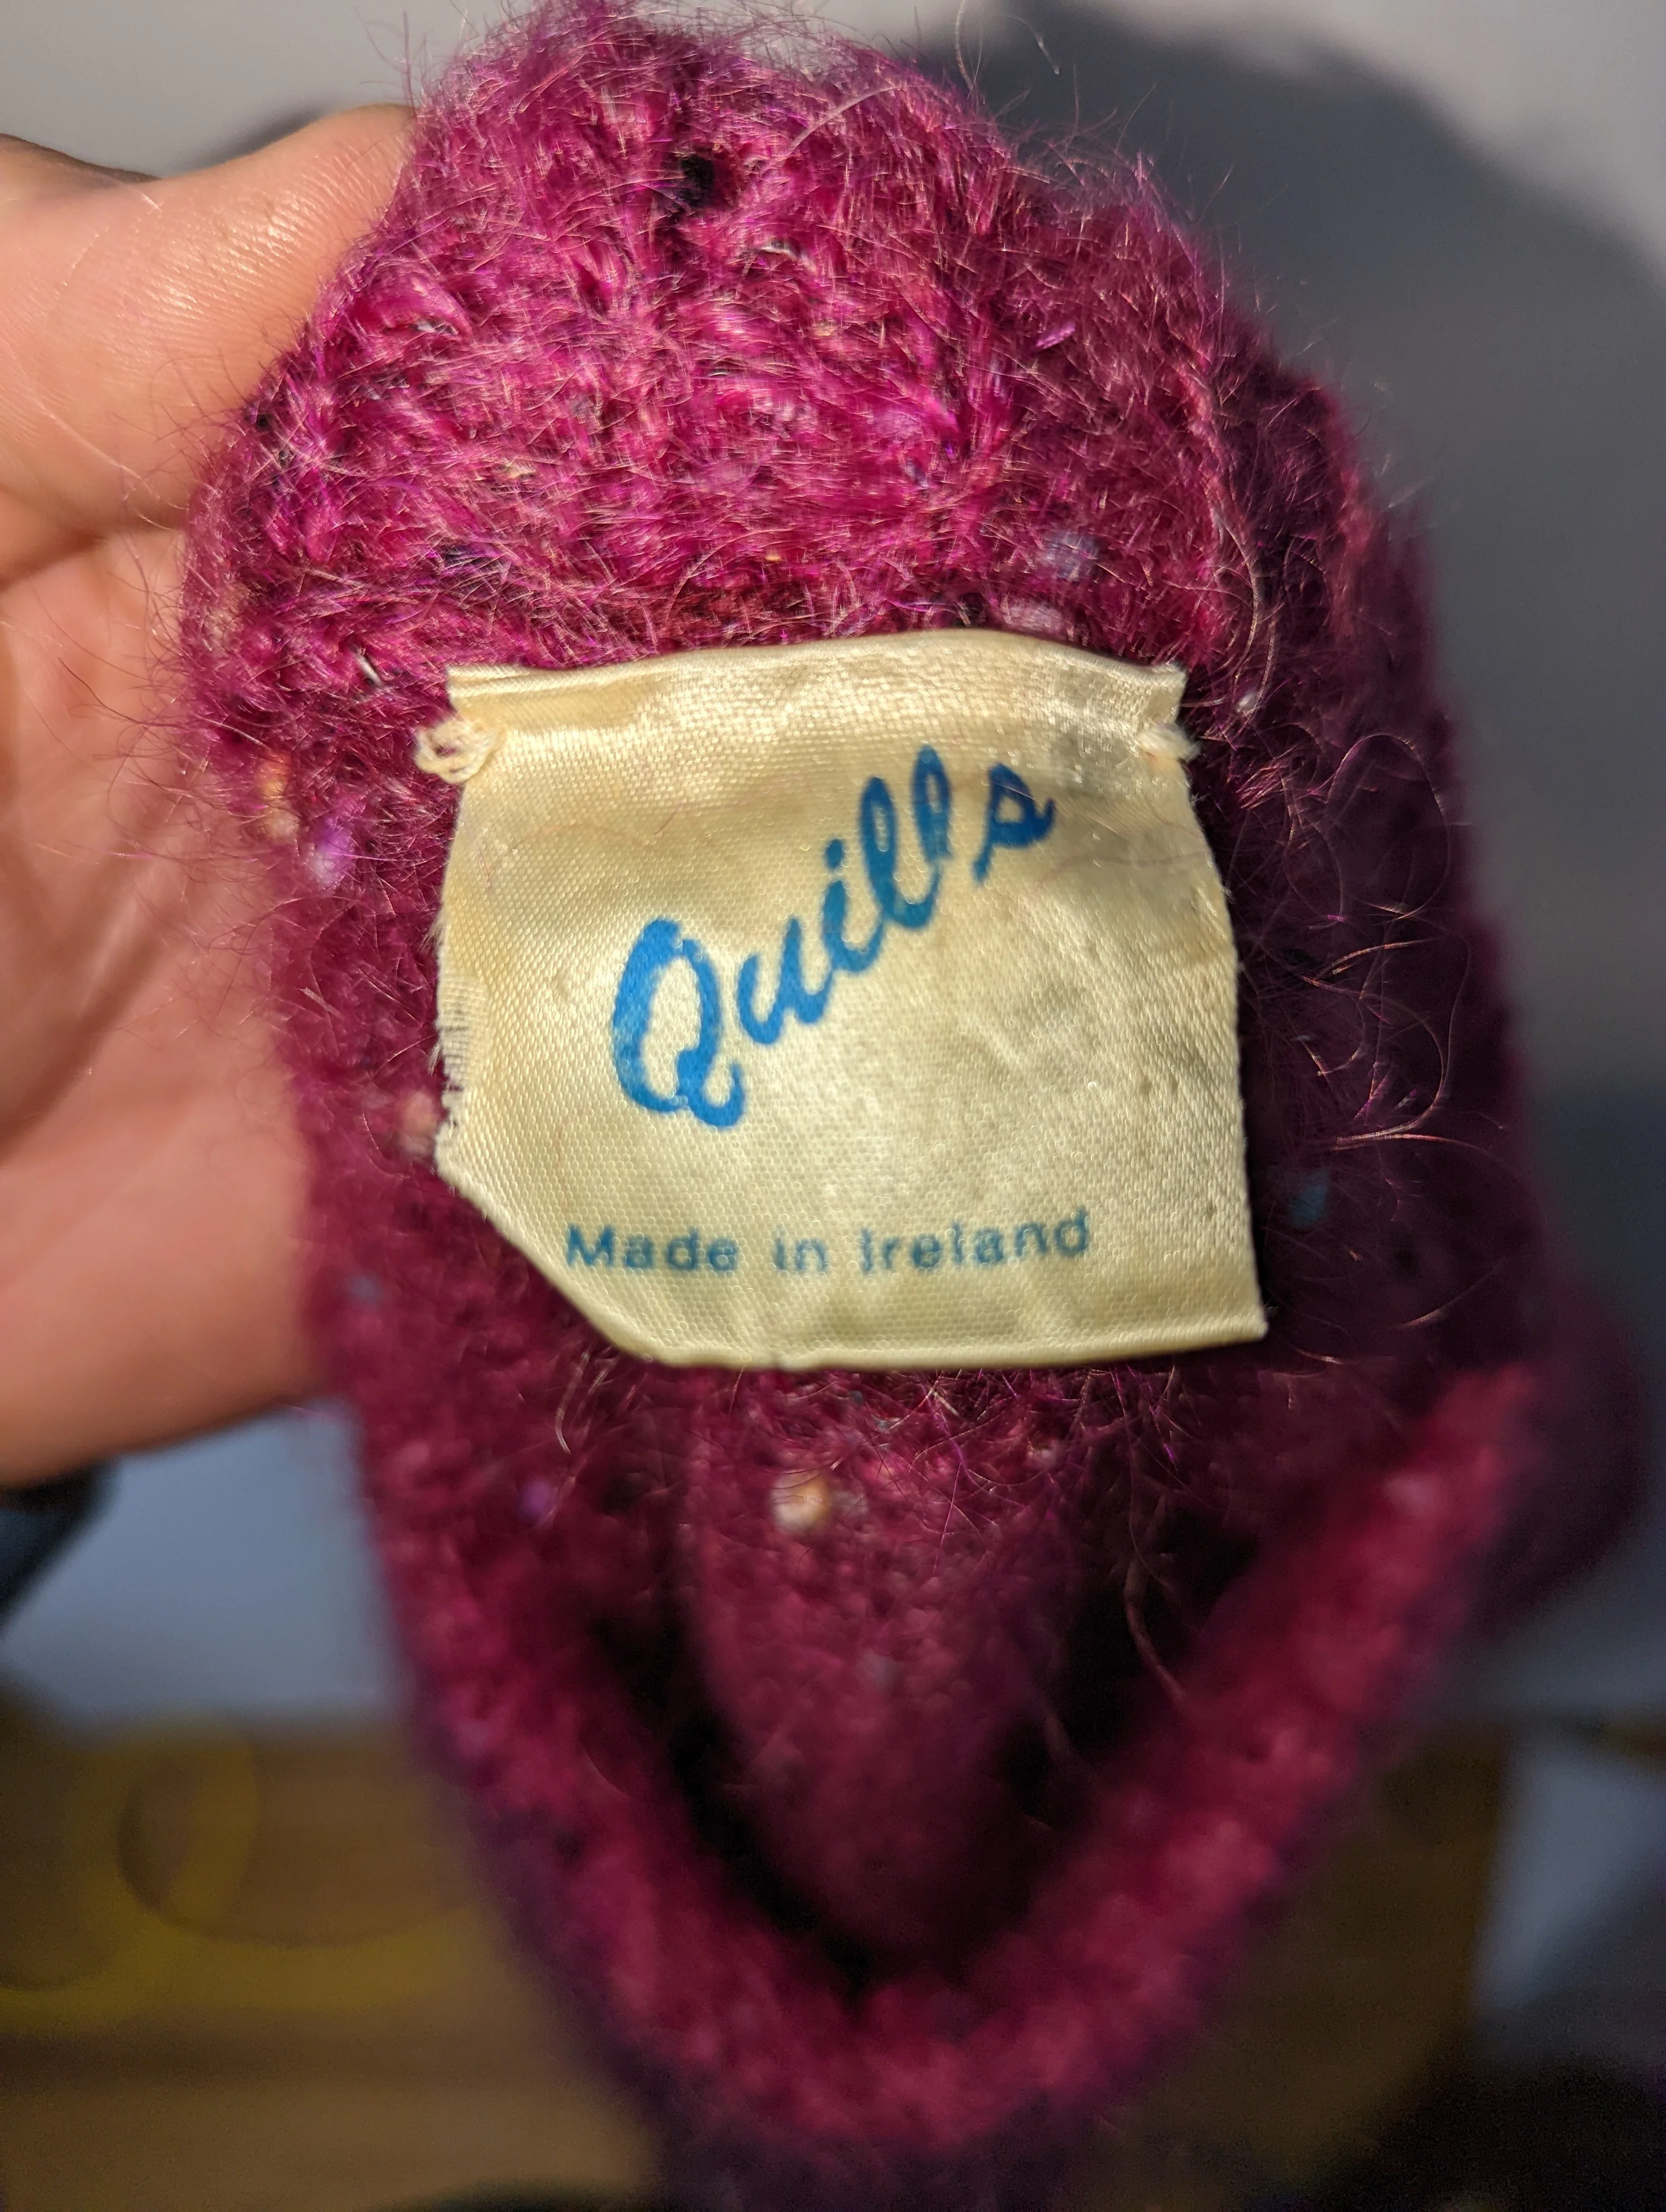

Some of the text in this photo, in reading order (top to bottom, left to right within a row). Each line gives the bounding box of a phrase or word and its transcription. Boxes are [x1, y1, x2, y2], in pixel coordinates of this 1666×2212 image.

[611, 744, 1056, 1131] Quills
[565, 1208, 1090, 1274] Made in Ireland
